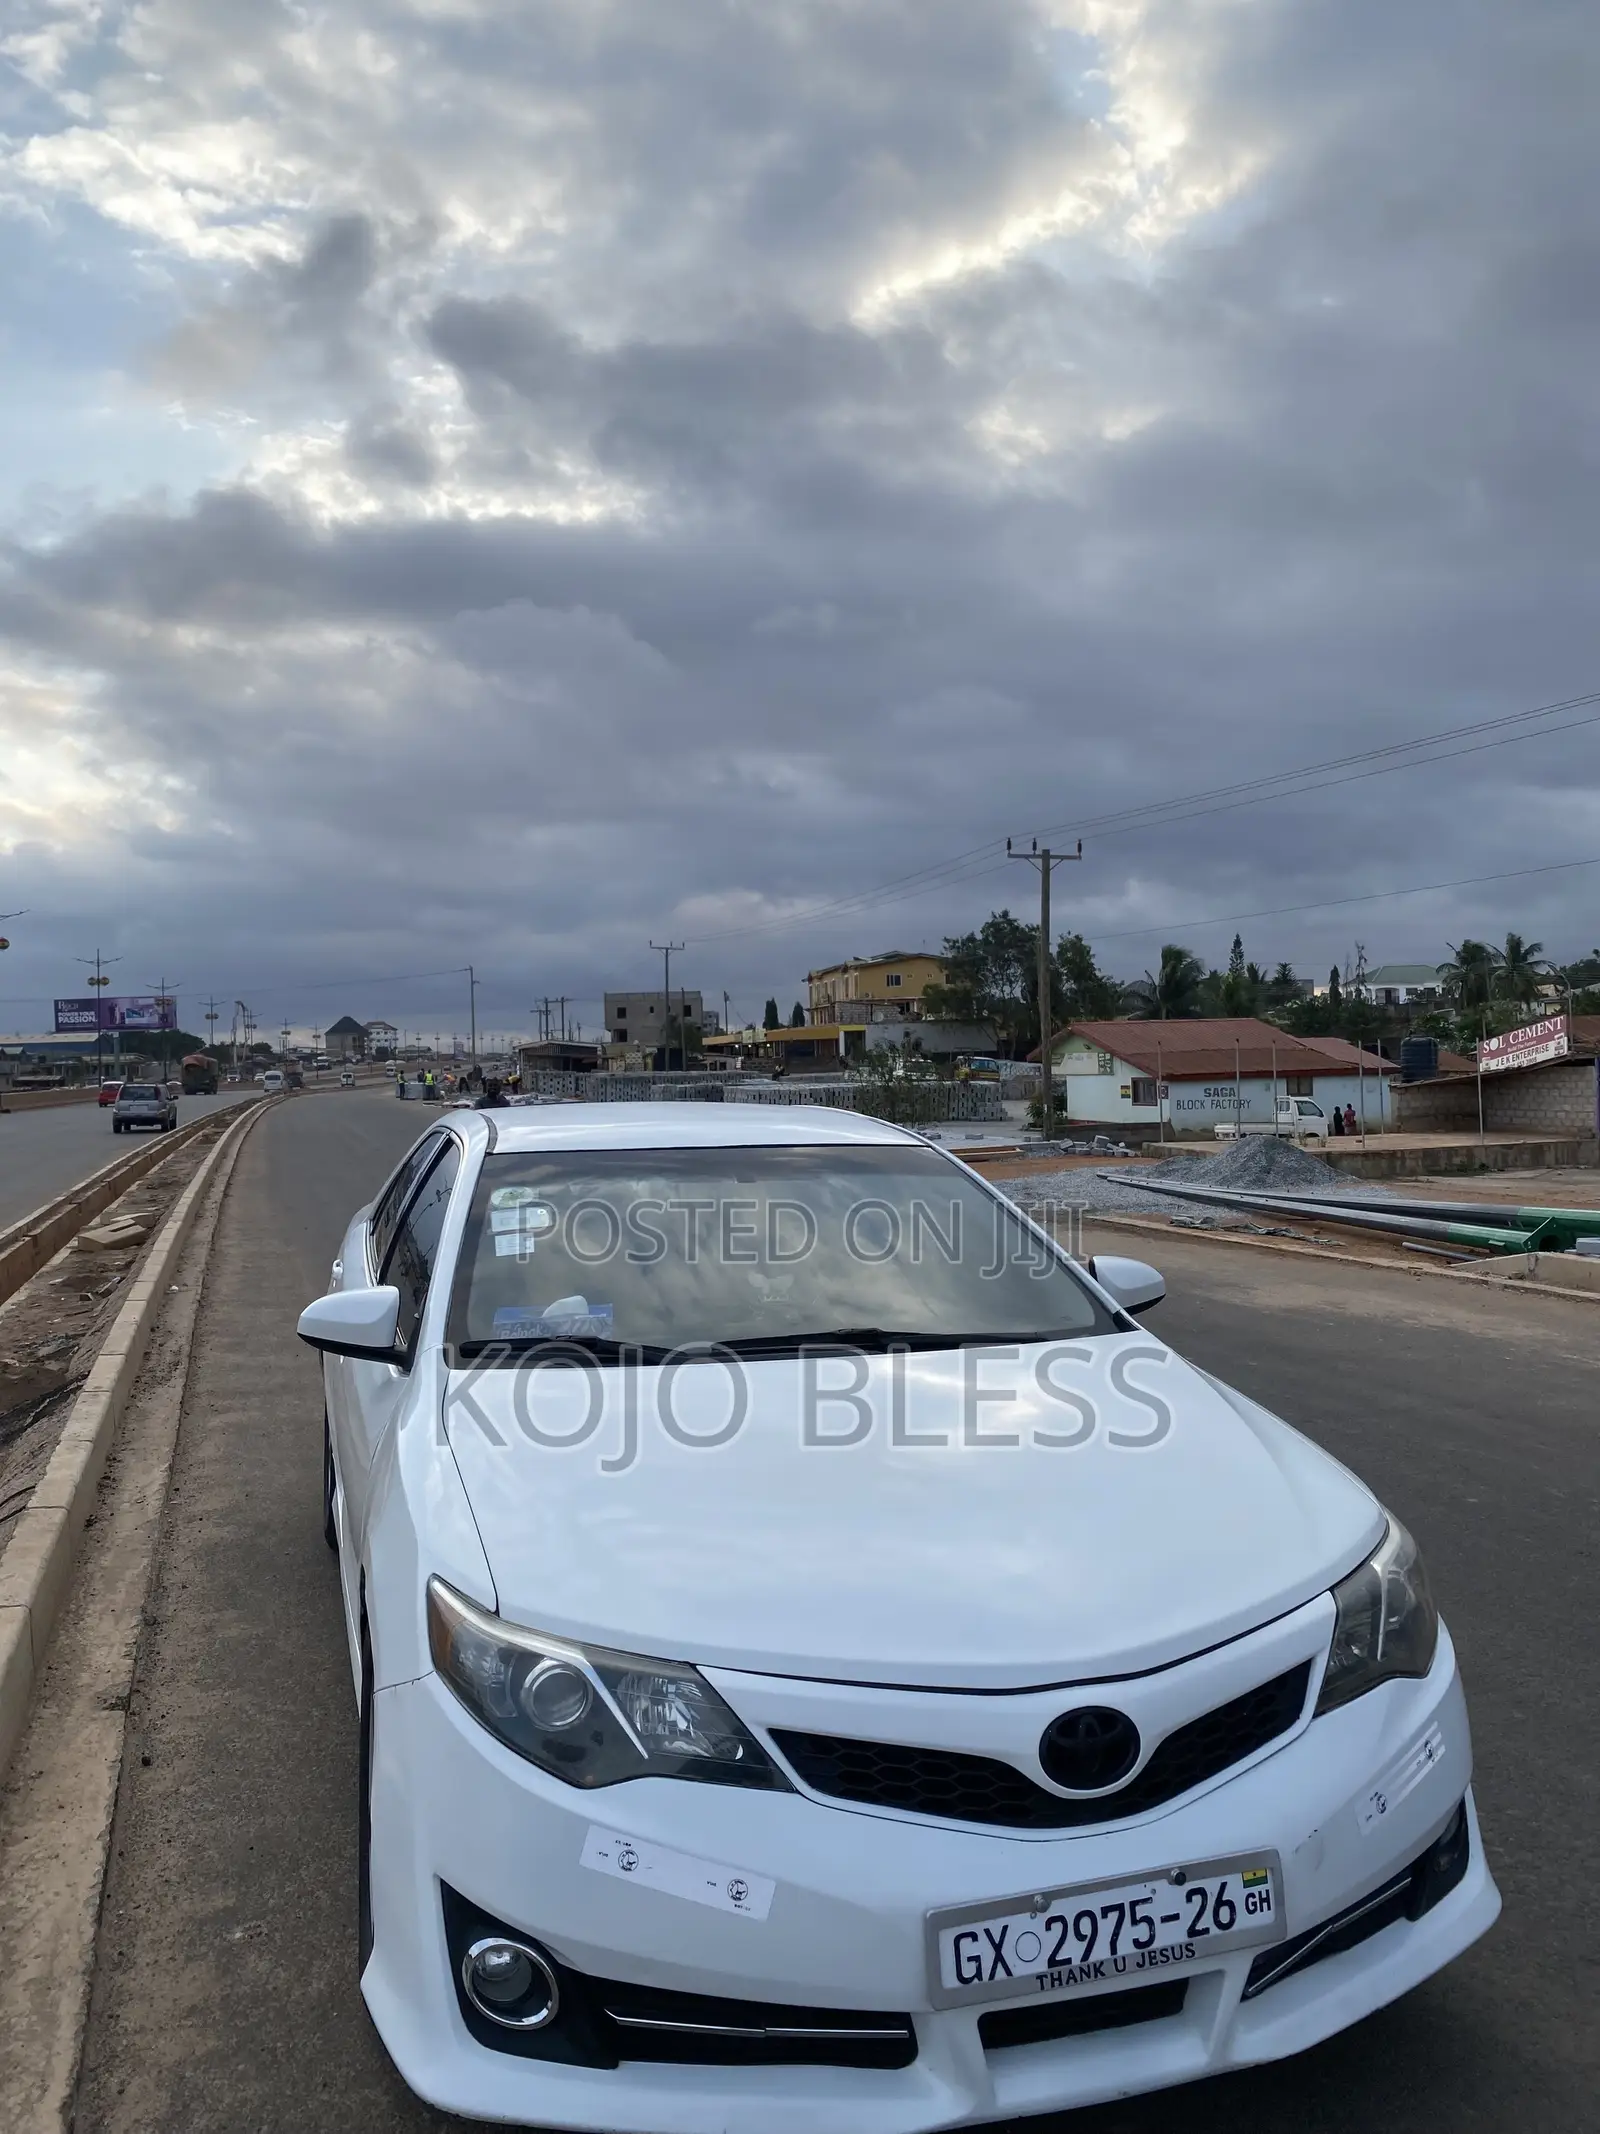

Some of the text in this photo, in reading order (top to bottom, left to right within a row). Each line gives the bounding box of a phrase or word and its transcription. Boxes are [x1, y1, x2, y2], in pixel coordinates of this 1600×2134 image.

[1509, 1016, 1564, 1044] CEMENT
[1512, 1044, 1549, 1062] ENTERPRISE
[1176, 1098, 1252, 1111] BLOCK FACTORY
[952, 1881, 1272, 1985] GX 2975-26 GH
[1035, 1942, 1197, 1991] THANK U JESUS
